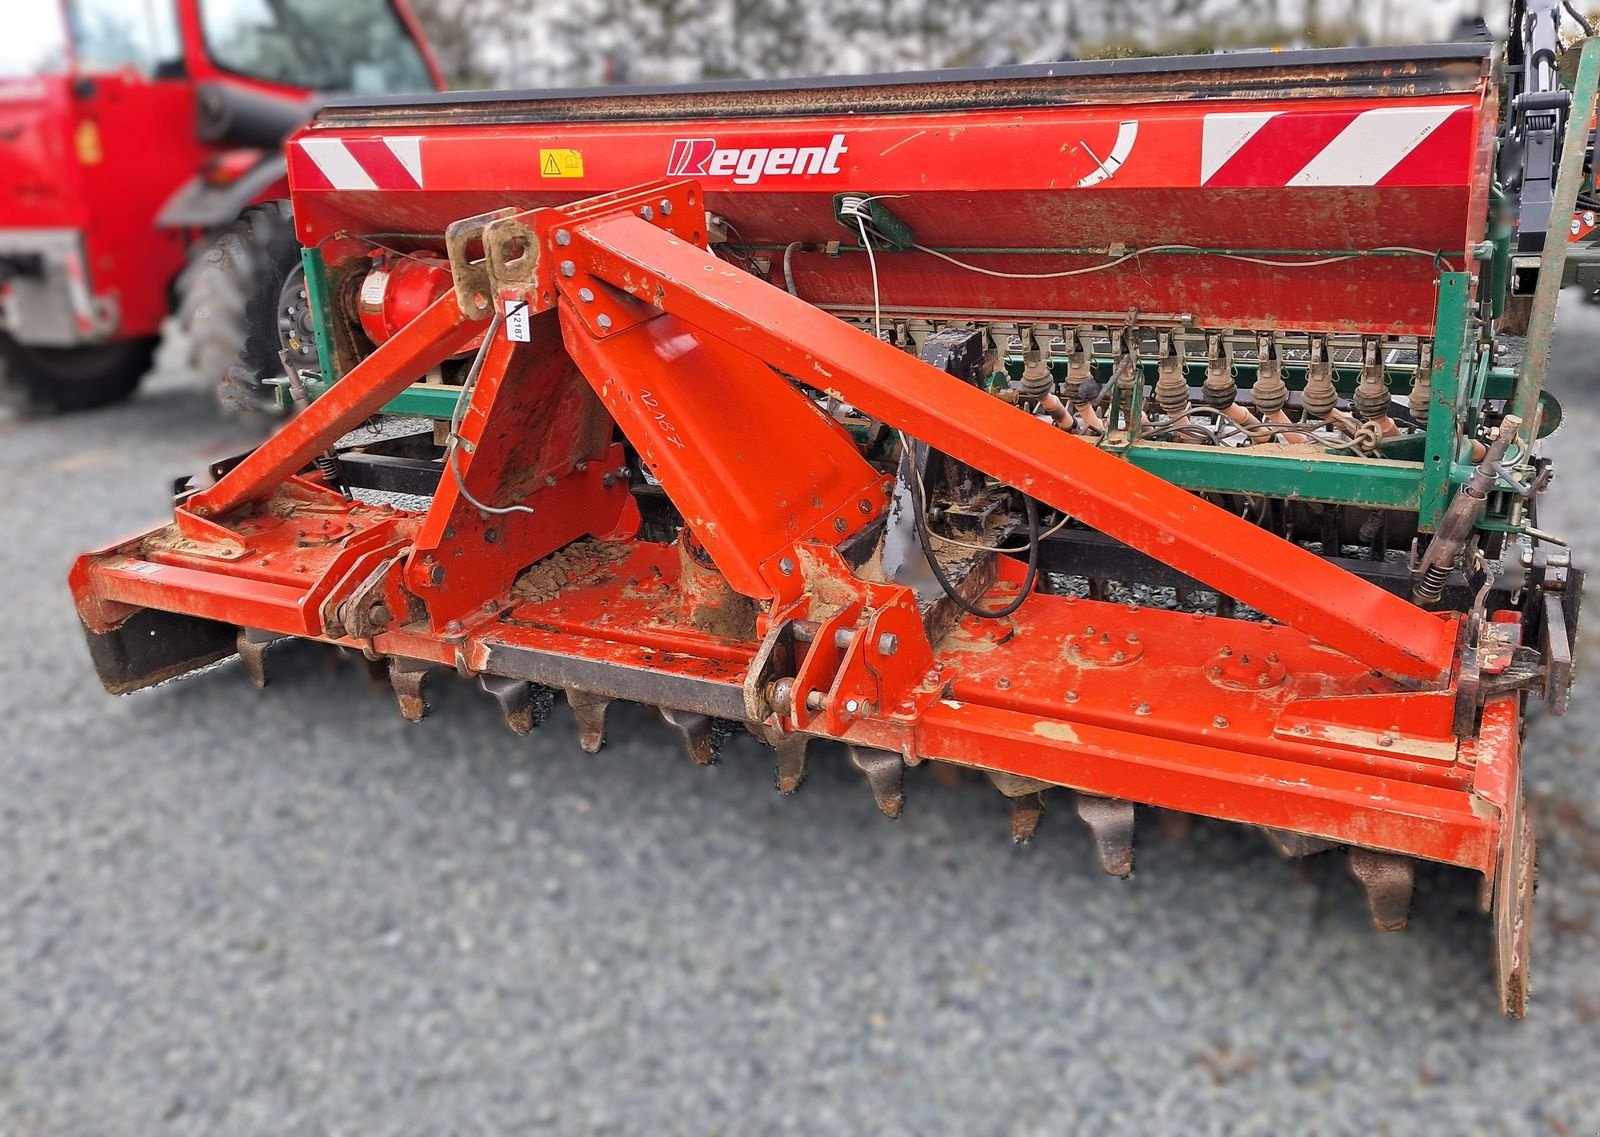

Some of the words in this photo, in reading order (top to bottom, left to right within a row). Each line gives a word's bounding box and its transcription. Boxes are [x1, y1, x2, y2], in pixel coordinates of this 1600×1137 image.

[666, 134, 848, 184] Regent
[513, 312, 523, 339] 12187
[640, 388, 685, 448] 12187
